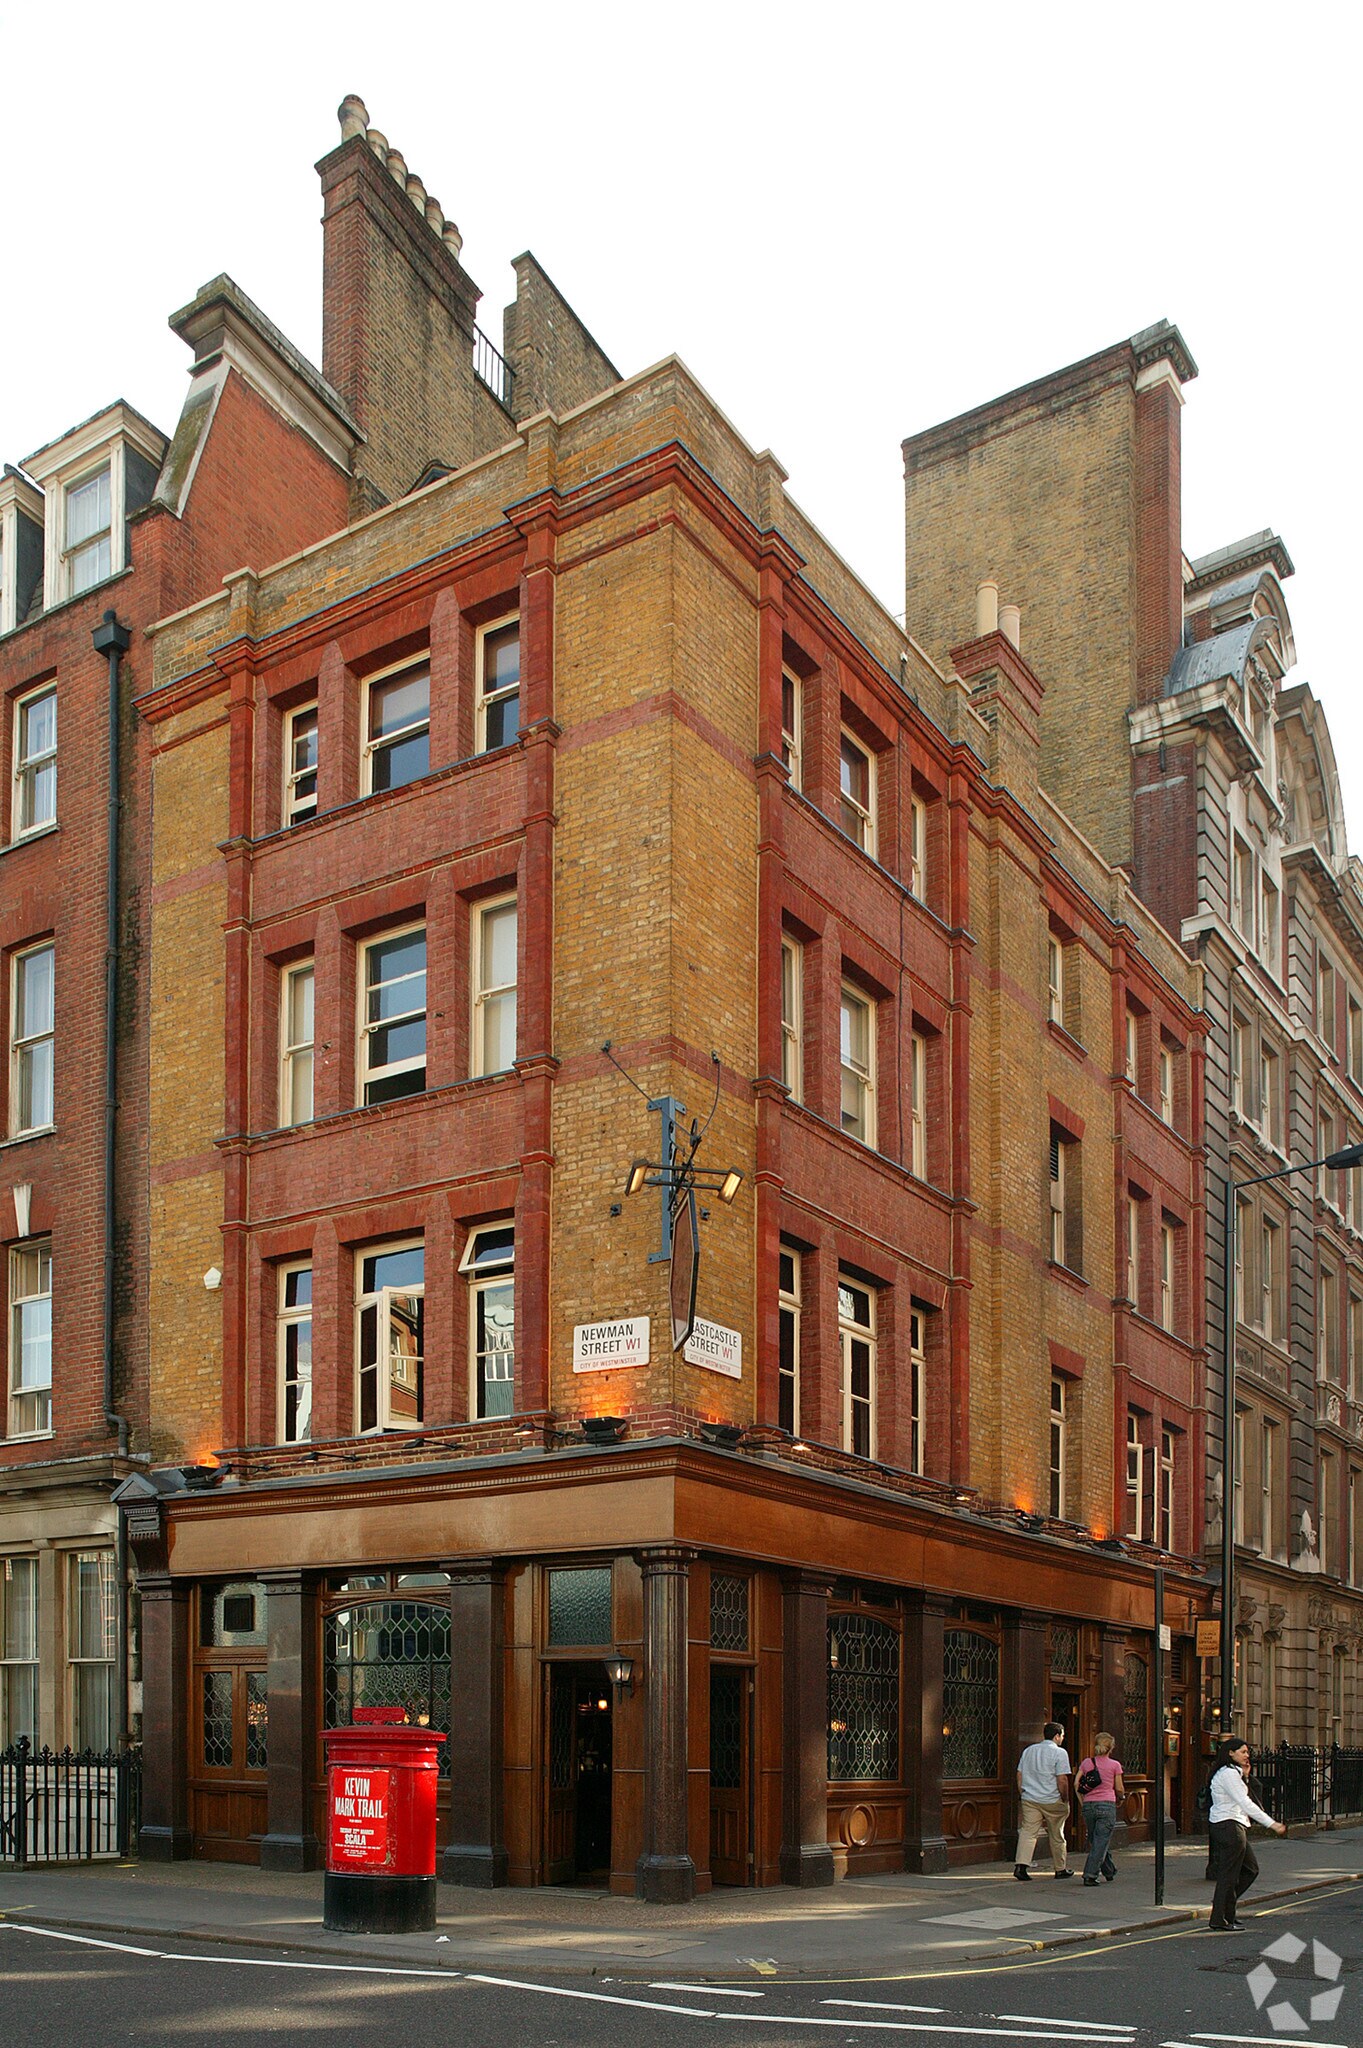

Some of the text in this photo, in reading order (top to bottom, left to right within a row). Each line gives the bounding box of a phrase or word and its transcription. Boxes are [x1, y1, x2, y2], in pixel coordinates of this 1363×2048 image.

[581, 1323, 634, 1342] NEWMAN
[692, 1321, 738, 1348] ASTCASTLE
[581, 1337, 641, 1356] STREET W1
[690, 1334, 733, 1360] STREET W1
[580, 1362, 591, 1370] CITY
[600, 1357, 637, 1367] WESTMINSTER
[344, 1777, 371, 1797] KEVIN
[334, 1796, 384, 1818] MARK TRAIL
[344, 1833, 366, 1846] SCALA
